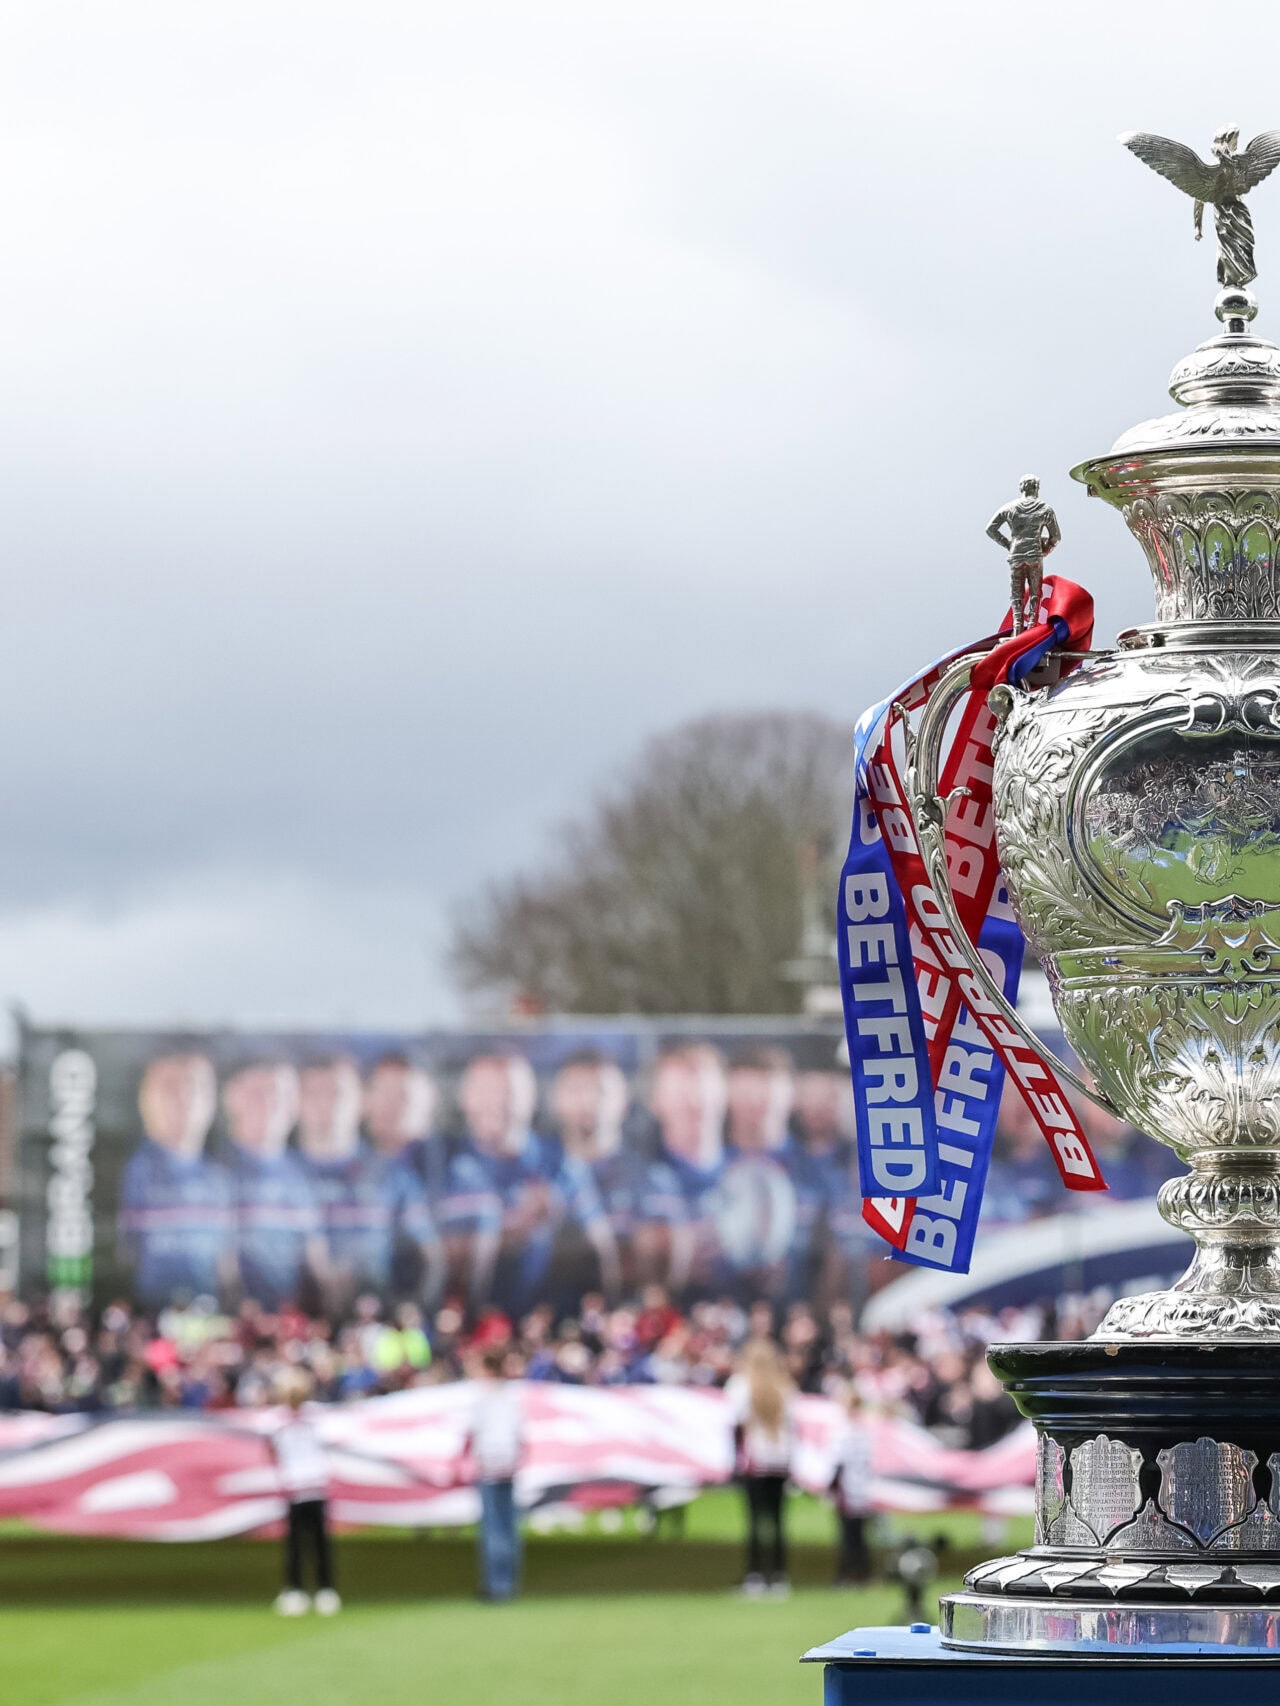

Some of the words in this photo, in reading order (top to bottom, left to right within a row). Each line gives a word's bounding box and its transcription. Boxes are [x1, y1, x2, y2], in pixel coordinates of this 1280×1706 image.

[944, 703, 998, 898] BETF
[844, 871, 927, 1192] BETFRED
[911, 884, 1096, 1179] BETFRED
